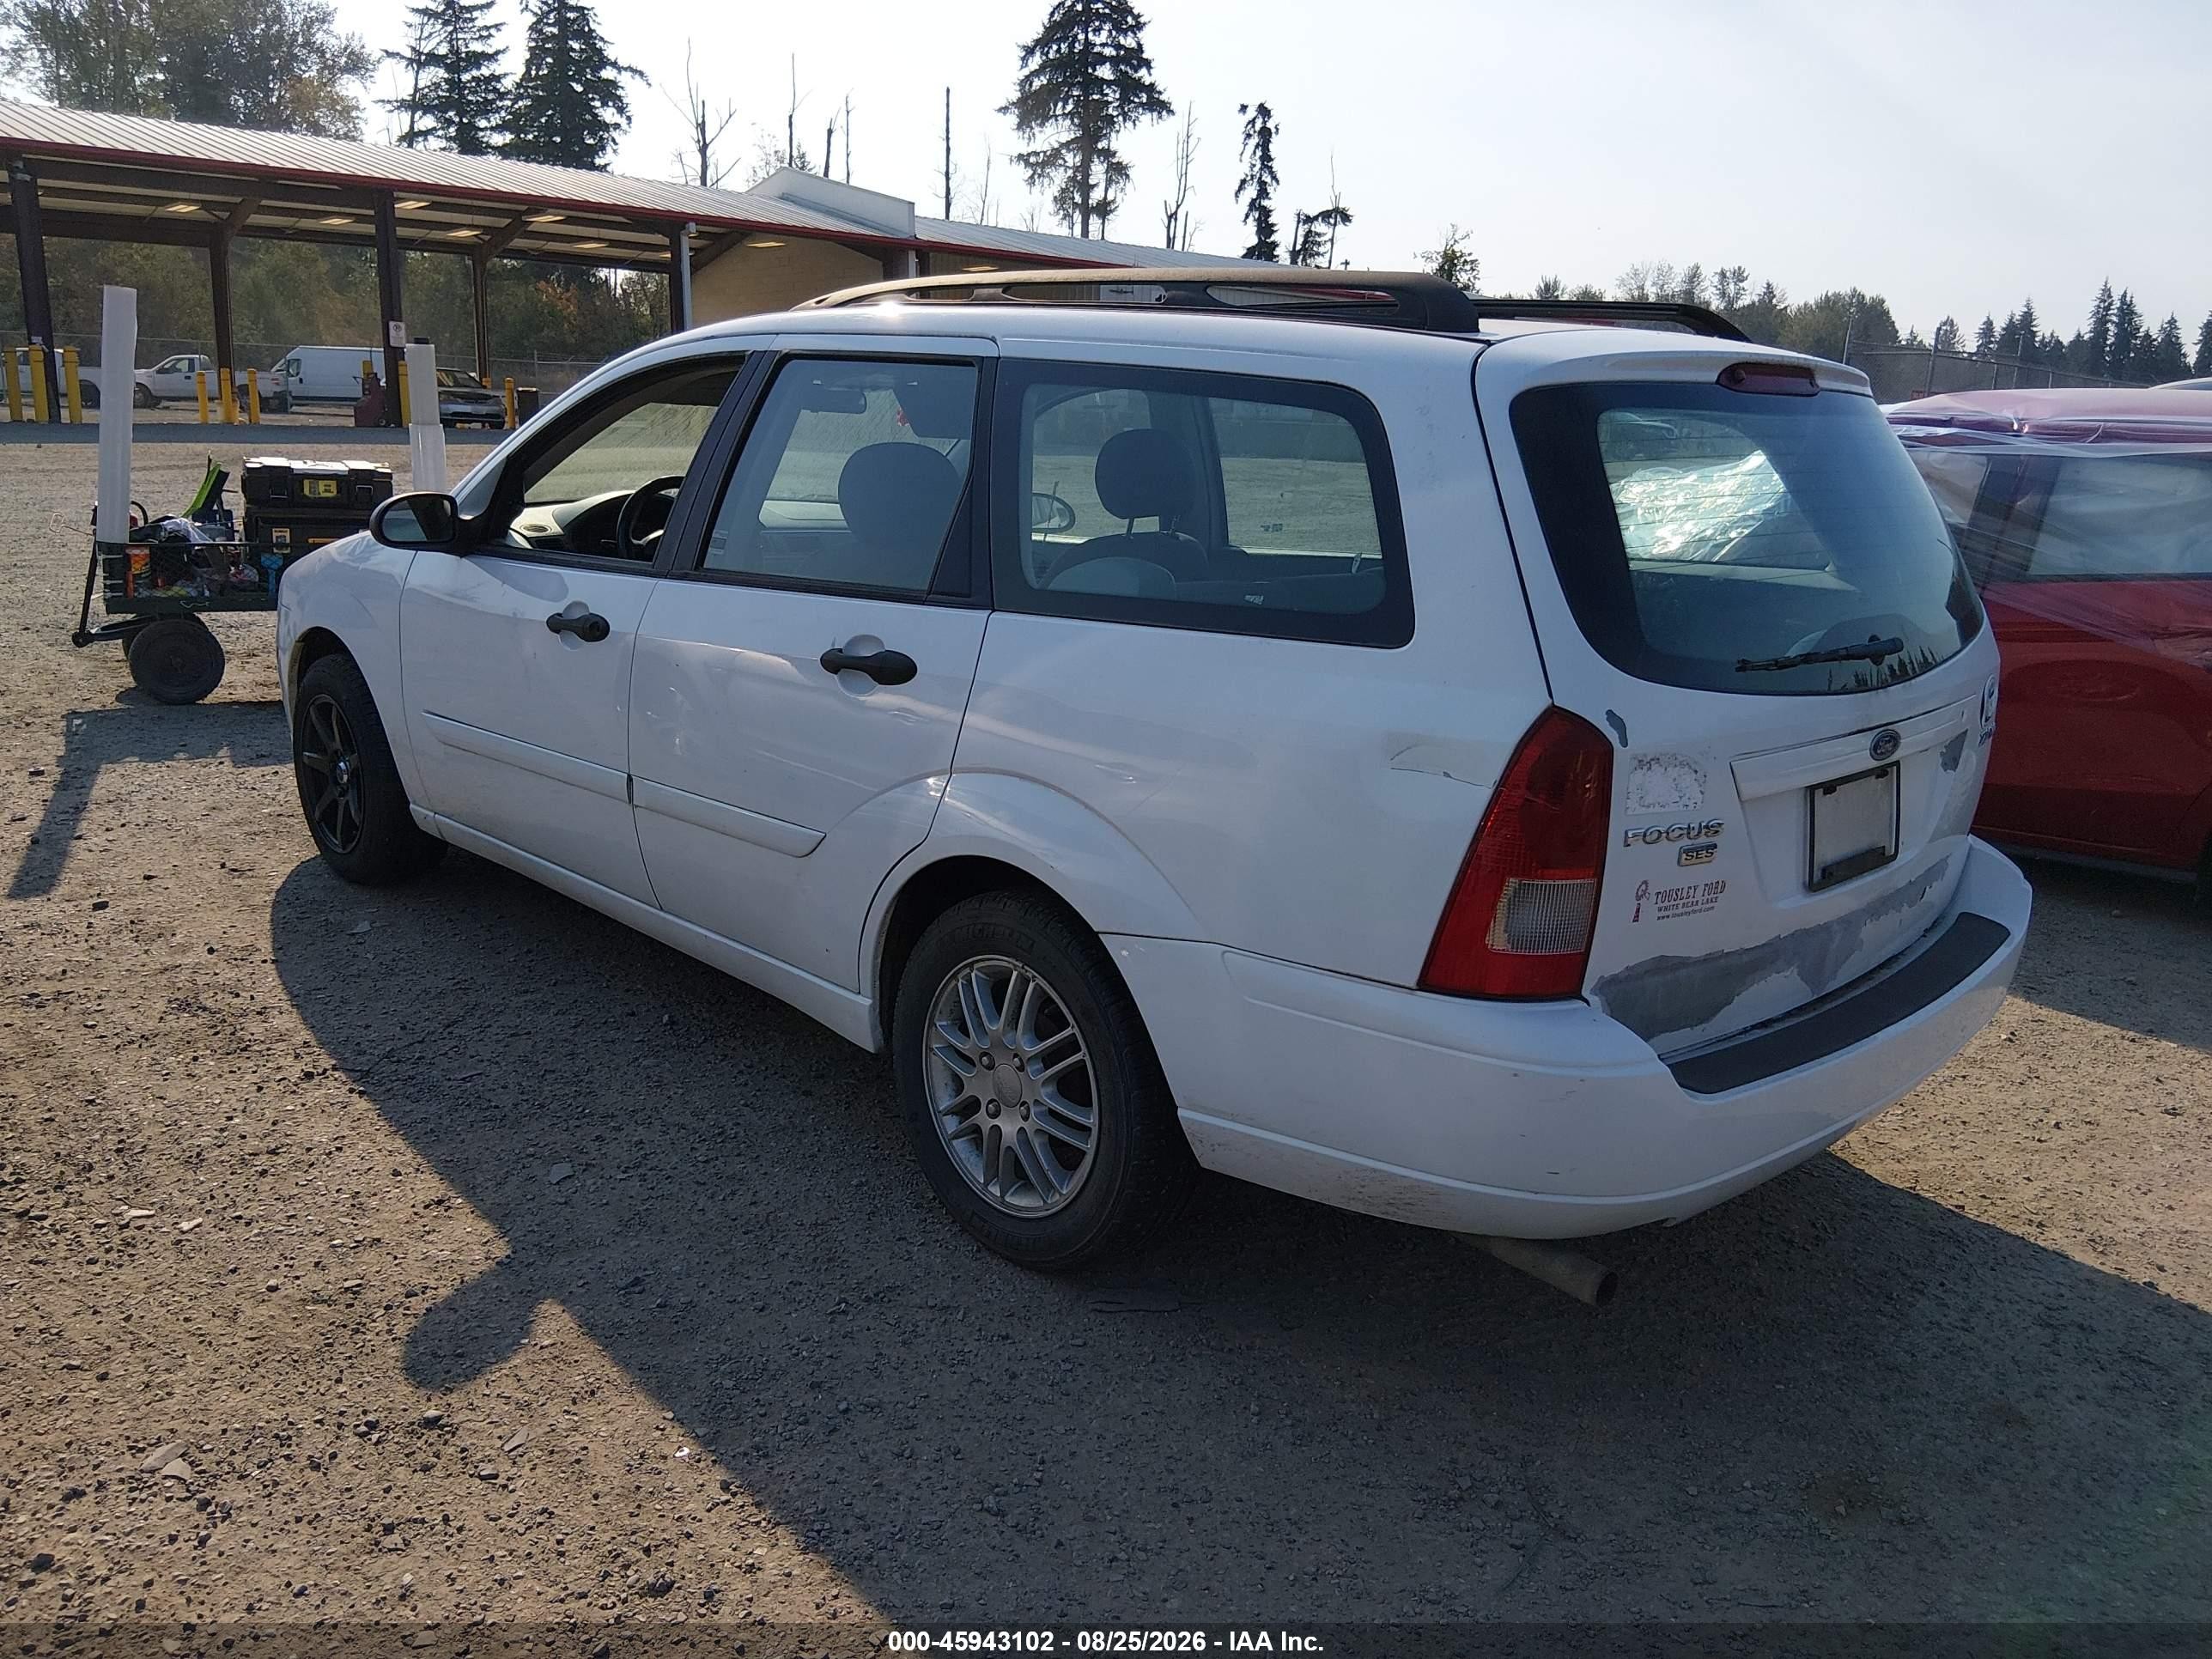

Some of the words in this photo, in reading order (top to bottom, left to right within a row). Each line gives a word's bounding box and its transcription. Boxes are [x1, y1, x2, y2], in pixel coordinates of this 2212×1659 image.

[1624, 817, 1724, 848] FOCUS
[1684, 848, 1715, 861] SES
[1654, 884, 1699, 905] TOUSLEY
[1702, 880, 1726, 897] FORD
[1657, 902, 1680, 913] WHITE
[1681, 900, 1699, 909] BEAR
[1701, 896, 1719, 906] LAKE
